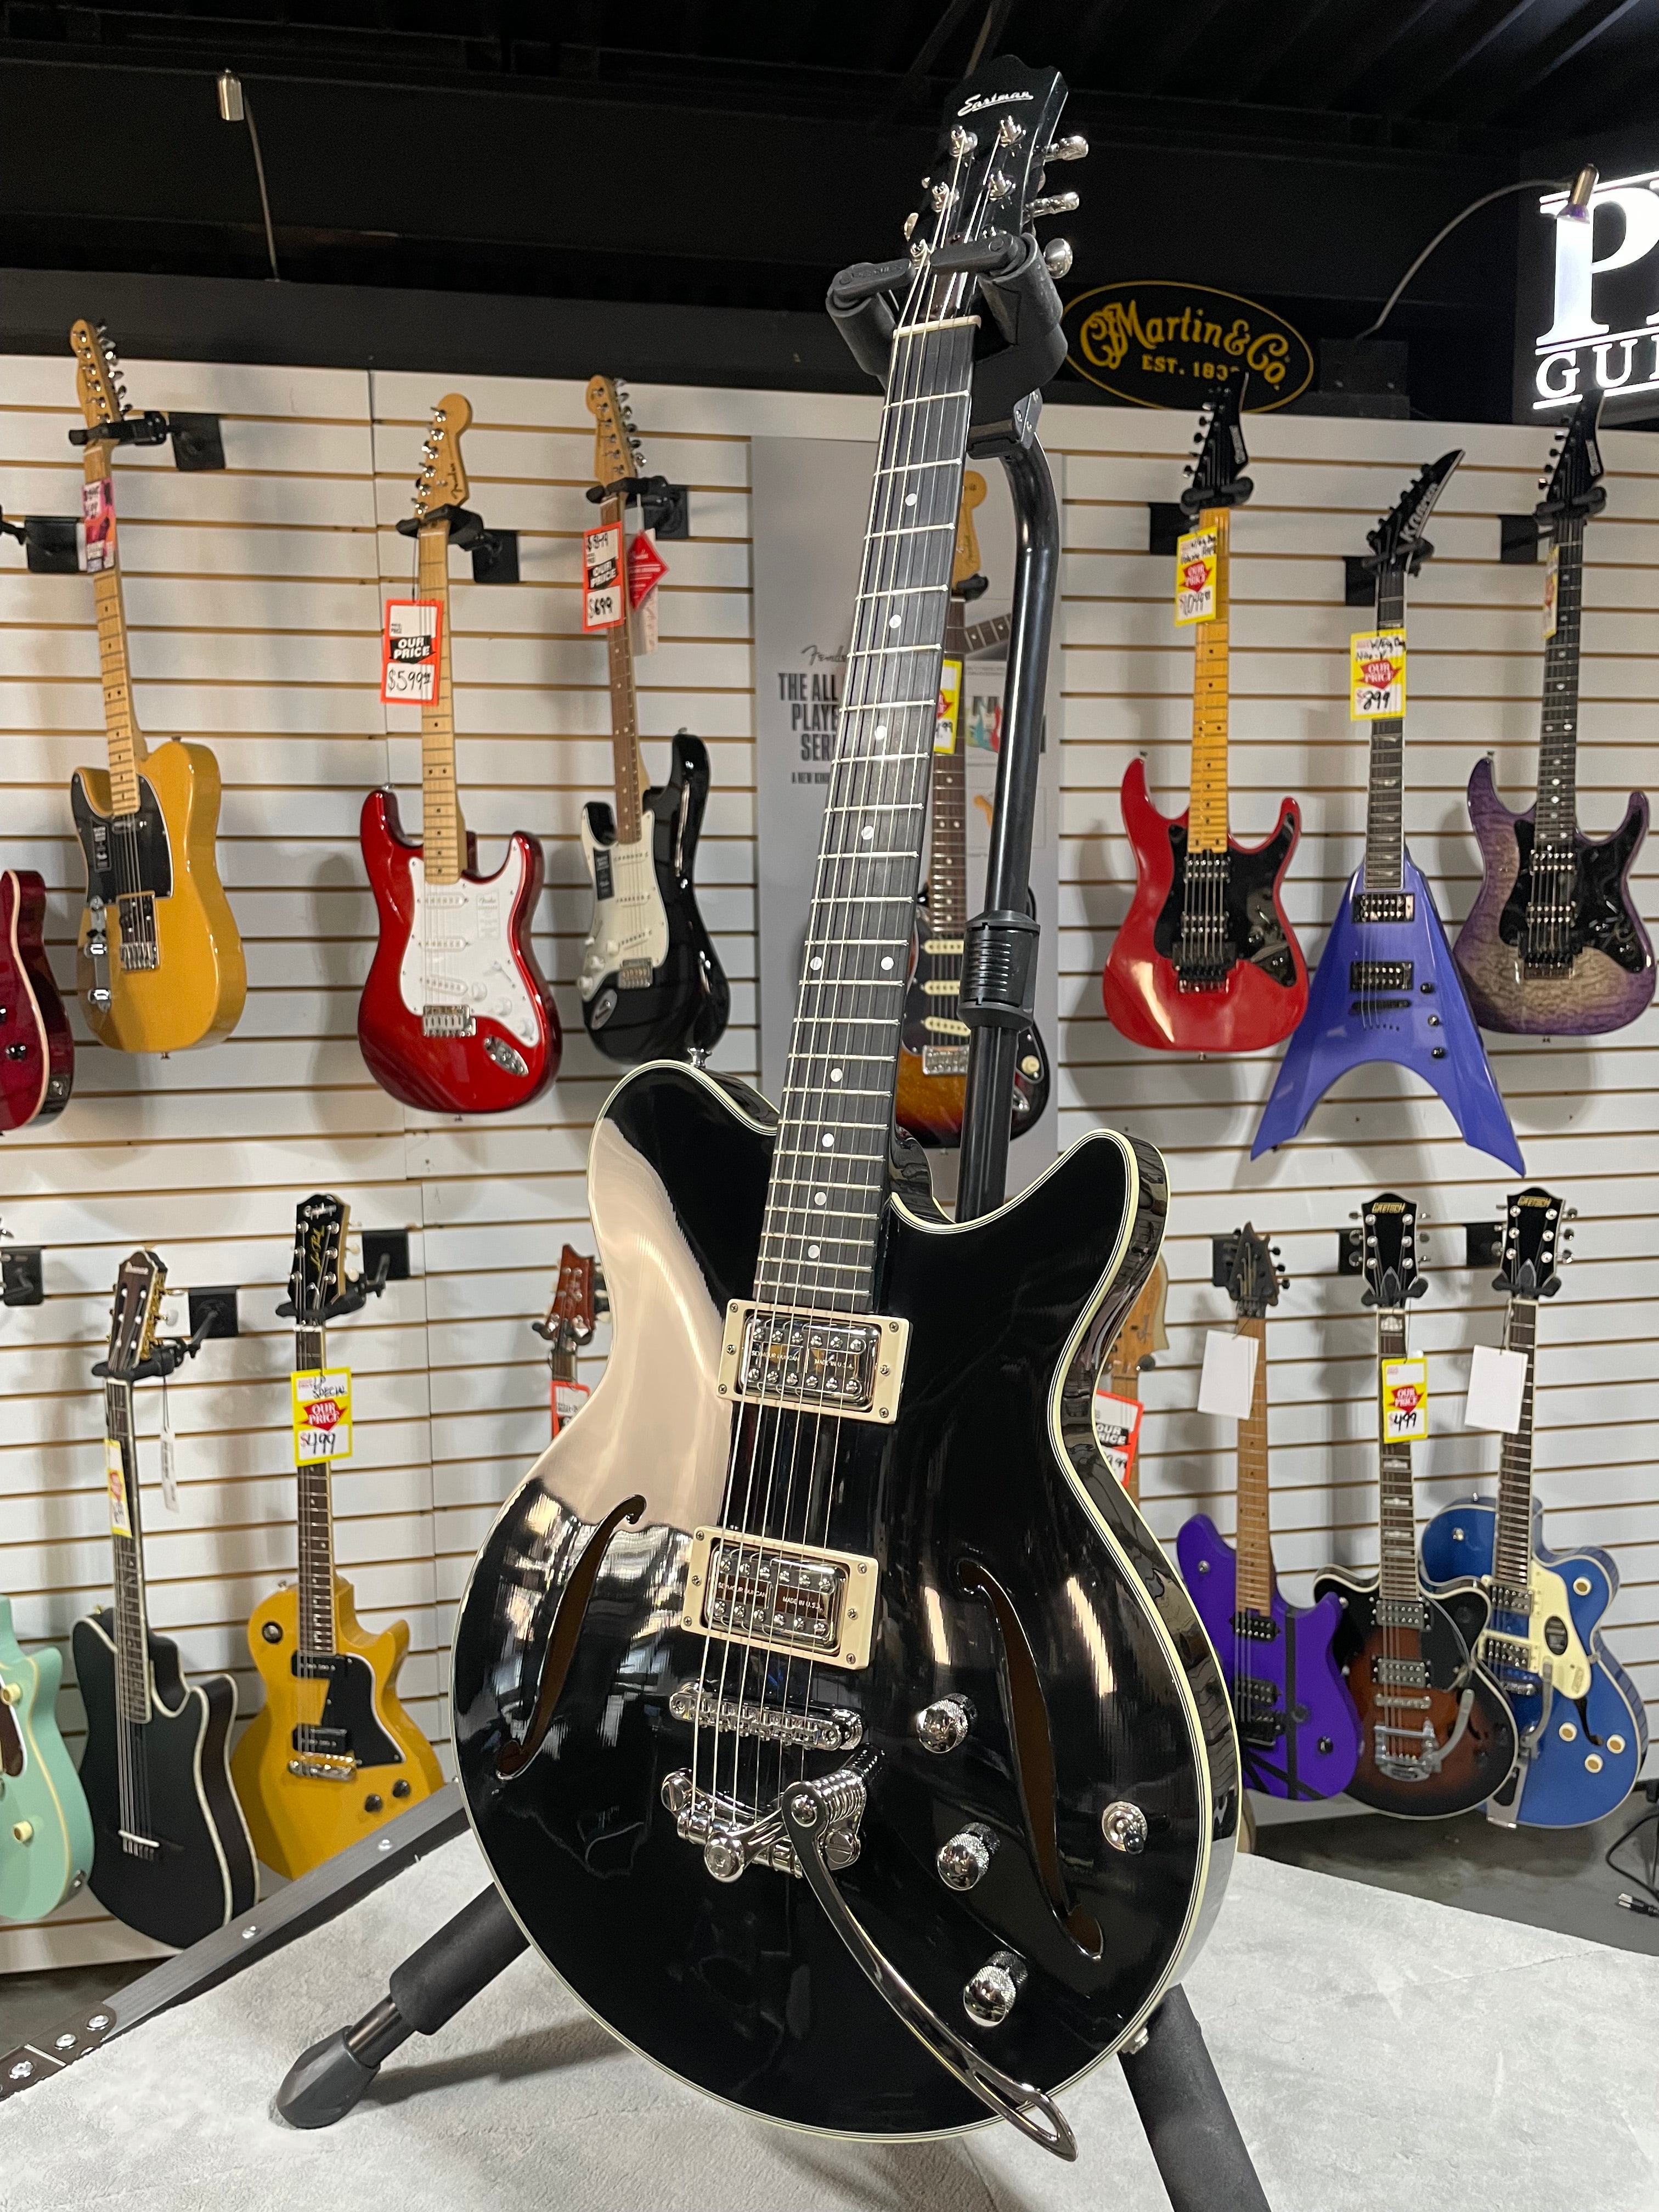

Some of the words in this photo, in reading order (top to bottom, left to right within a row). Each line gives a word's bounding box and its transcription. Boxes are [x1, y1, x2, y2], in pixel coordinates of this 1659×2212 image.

[957, 91, 1034, 117] Eastman
[1536, 185, 1659, 346] P
[1142, 353, 1185, 375] EST.
[592, 560, 613, 577] OUR
[398, 637, 425, 649] OUR
[393, 645, 431, 659] PRICE
[801, 645, 848, 666] Fende
[1368, 662, 1390, 674] OUR
[1365, 672, 1392, 684] PRICE
[778, 673, 808, 701] THE
[812, 674, 839, 701] ALL
[792, 703, 839, 731] PLAYE
[1372, 1202, 1406, 1214] GRETSCH
[1397, 1388, 1415, 1398] OUR
[312, 1402, 336, 1415] OUR
[308, 1411, 340, 1425] PRICE
[1096, 1424, 1122, 1435] OUR
[1096, 1432, 1127, 1445] RICE
[718, 1582, 743, 1593] SEYMR
[782, 1596, 798, 1605] MADE
